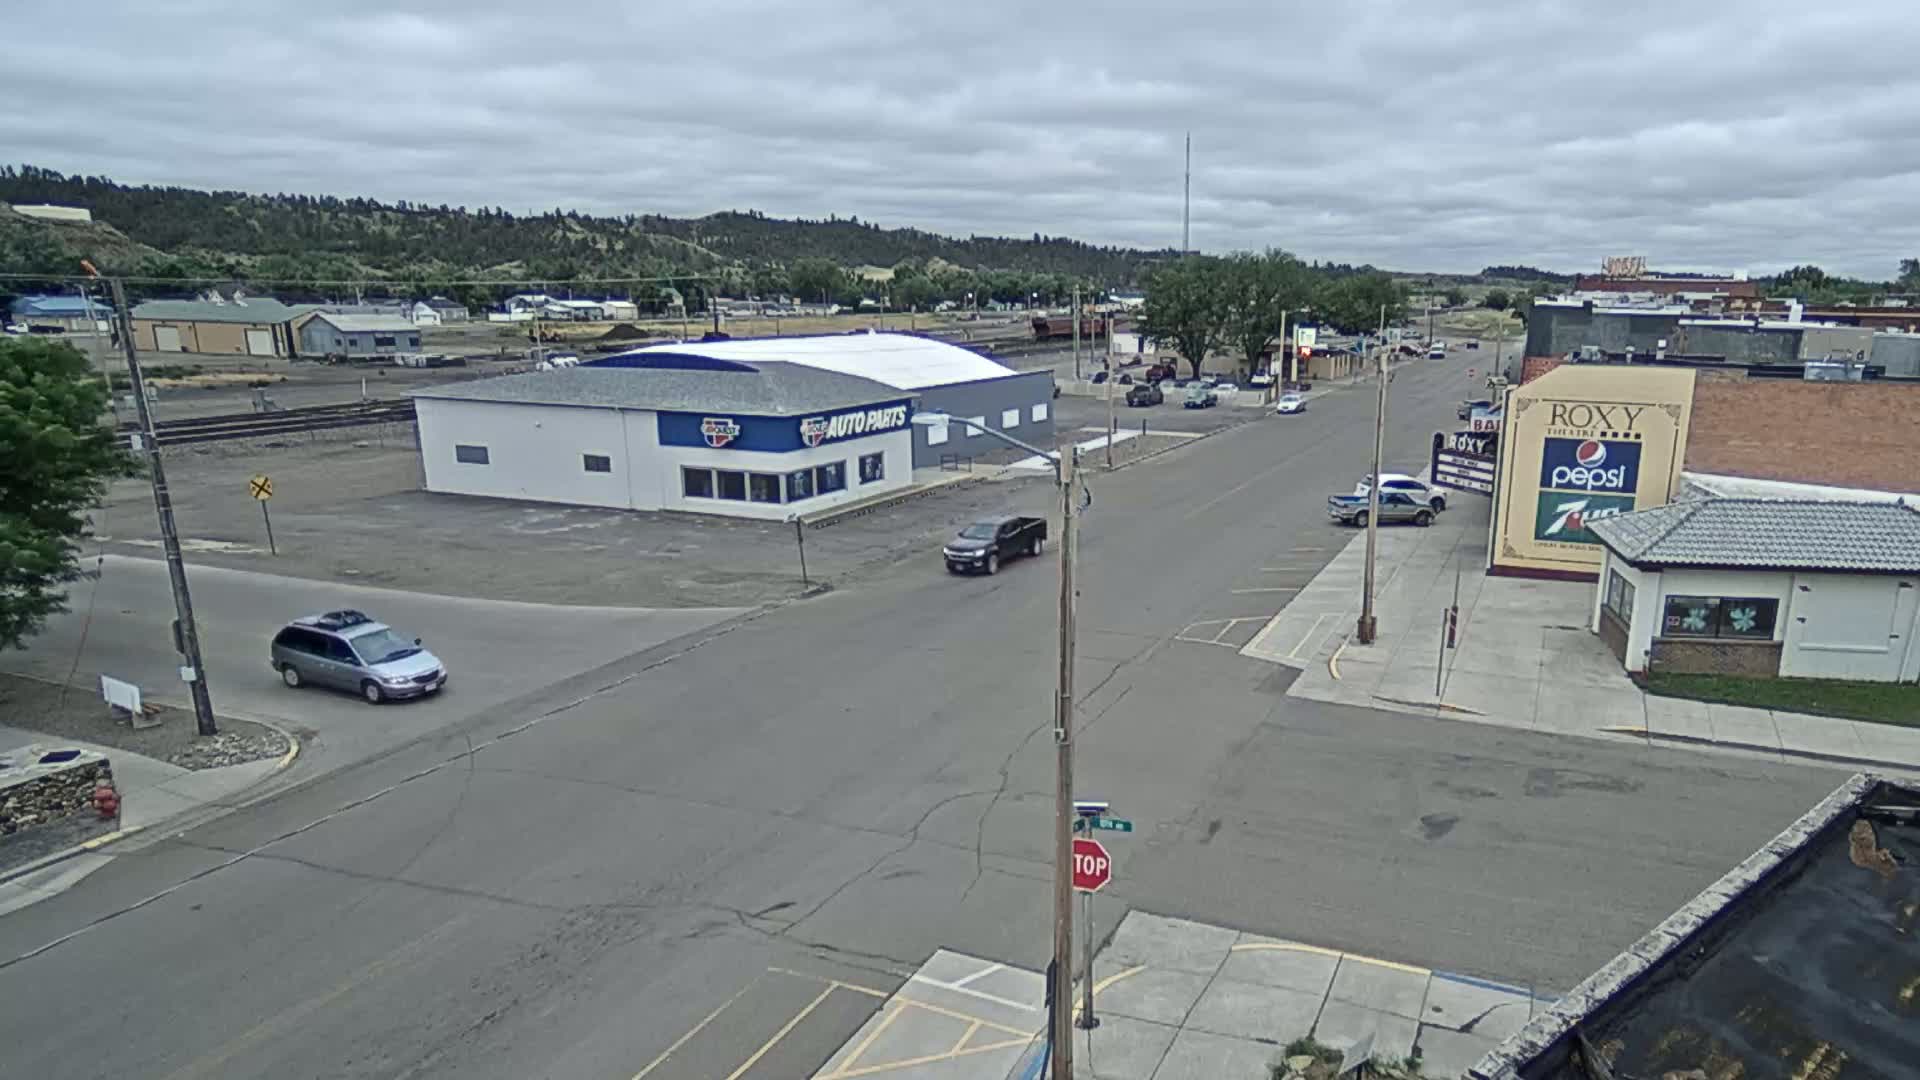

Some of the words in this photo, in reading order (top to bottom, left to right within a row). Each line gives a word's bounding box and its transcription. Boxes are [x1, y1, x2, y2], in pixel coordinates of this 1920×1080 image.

[825, 411, 866, 439] AUTO
[865, 404, 907, 431] PARTS
[1545, 403, 1643, 430] ROXY
[1449, 433, 1487, 455] ROXY
[1551, 464, 1626, 491] pepsi
[1073, 853, 1108, 877] TOP
